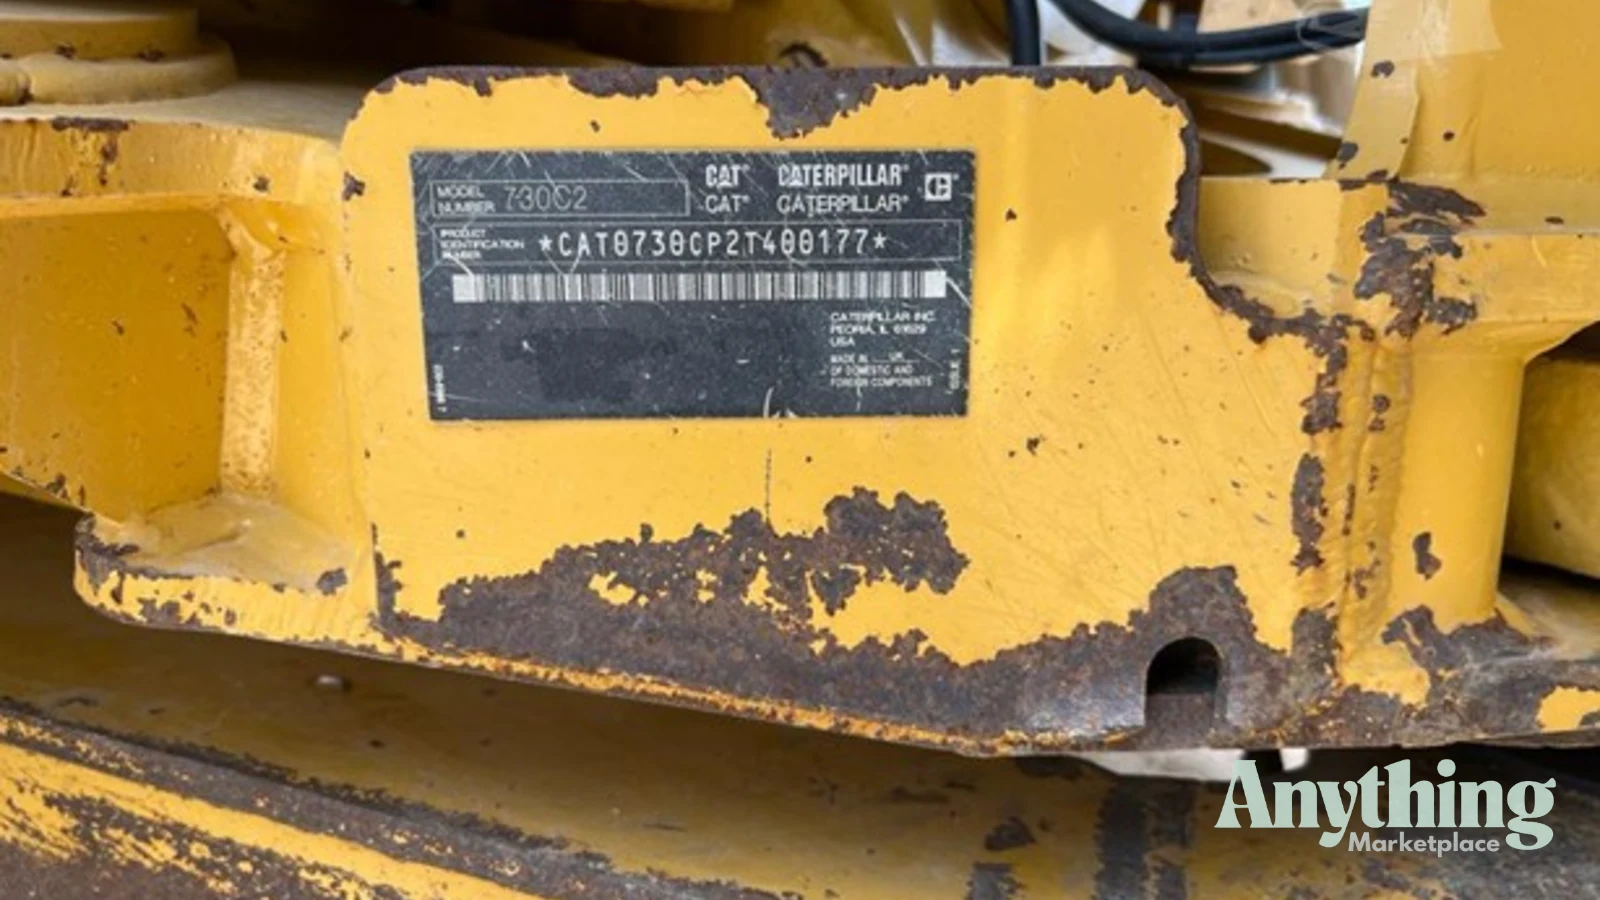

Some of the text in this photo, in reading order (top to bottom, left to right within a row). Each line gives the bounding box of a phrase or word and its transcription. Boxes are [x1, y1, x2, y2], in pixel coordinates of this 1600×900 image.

[437, 184, 485, 199] MODEL
[503, 185, 588, 211] 730C2
[437, 200, 496, 214] NUMBER
[829, 311, 911, 323] CATERPILLAR
[828, 336, 855, 348] USA
